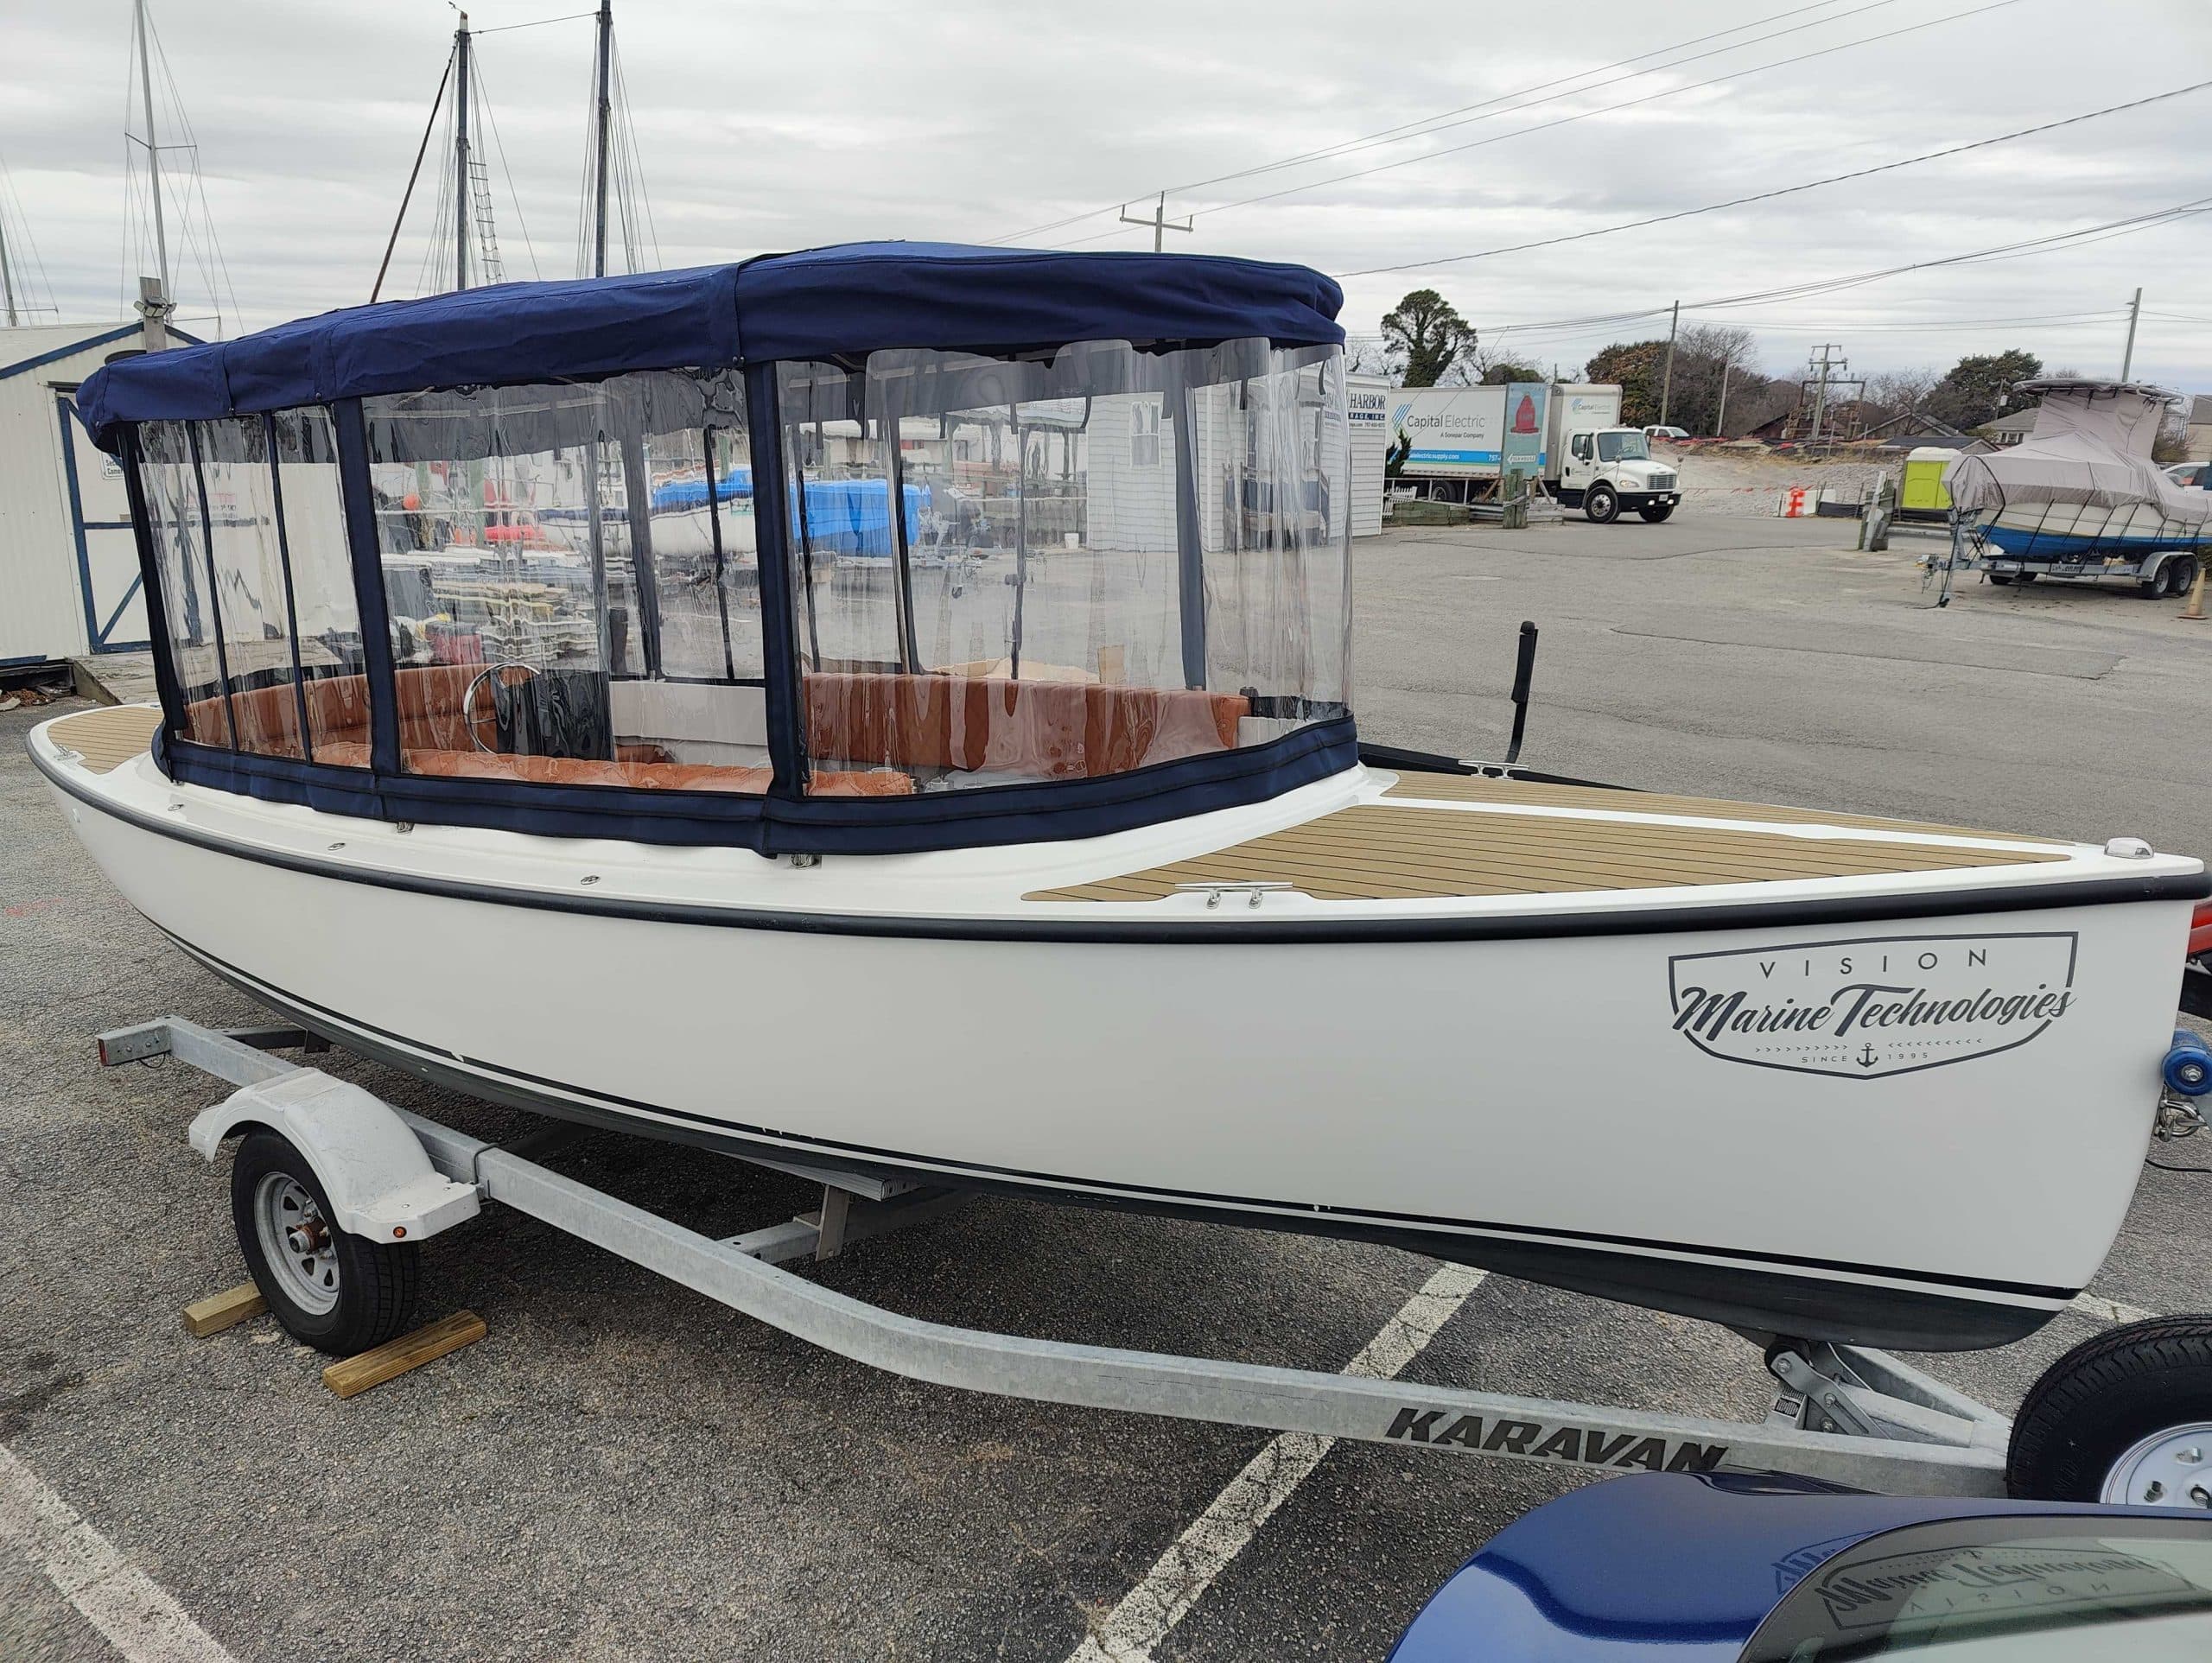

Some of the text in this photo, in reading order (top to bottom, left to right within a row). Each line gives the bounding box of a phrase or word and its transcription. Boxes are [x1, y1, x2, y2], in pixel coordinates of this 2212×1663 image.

[1350, 393, 1386, 409] HARBOR
[1407, 415, 1485, 429] Capital Electric
[1759, 949, 1987, 979] VISION
[1672, 983, 2077, 1042] Marine Technologies
[1801, 1055, 1847, 1063] SINCE
[1385, 1407, 1728, 1471] KARAVAN
